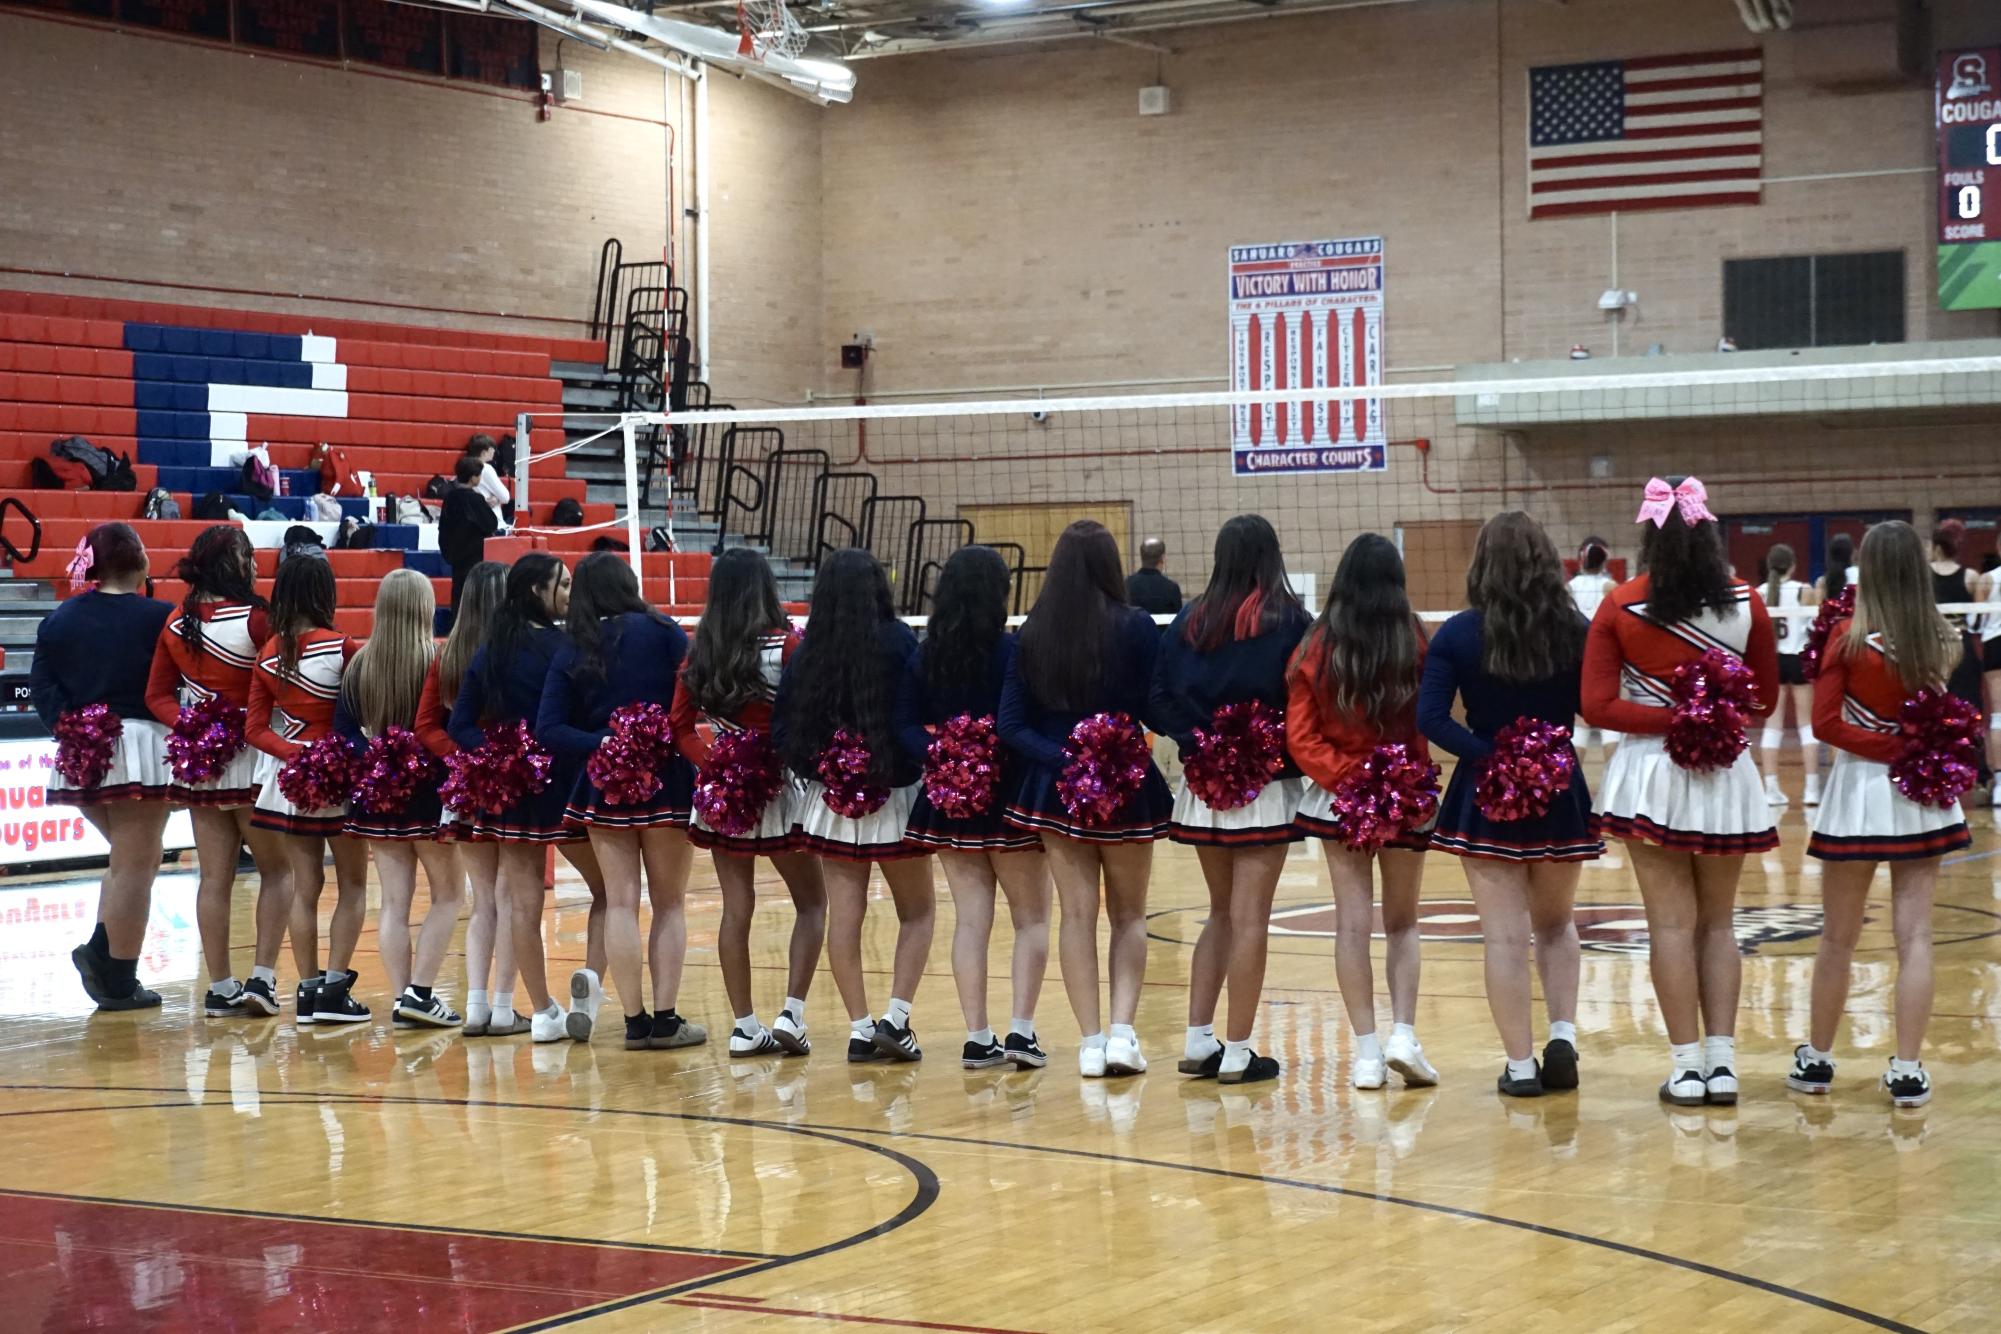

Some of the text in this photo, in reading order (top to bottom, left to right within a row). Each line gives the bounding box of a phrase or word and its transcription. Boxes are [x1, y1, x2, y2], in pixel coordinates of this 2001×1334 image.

[1944, 169, 1985, 186] FOULS
[1958, 185, 1980, 218] 0
[1944, 223, 1985, 240] SCORE
[1233, 239, 1380, 261] SAHUARO COUGARS
[1235, 267, 1378, 299] VICTORY WITH HONOR
[1235, 302, 1253, 311] THE
[1264, 299, 1303, 309] PILLARS
[1305, 298, 1319, 306] OF
[1264, 331, 1272, 429] RESPCT
[1246, 448, 1371, 470] CHARACTER COUNTS
[0, 816, 85, 852] ugars
